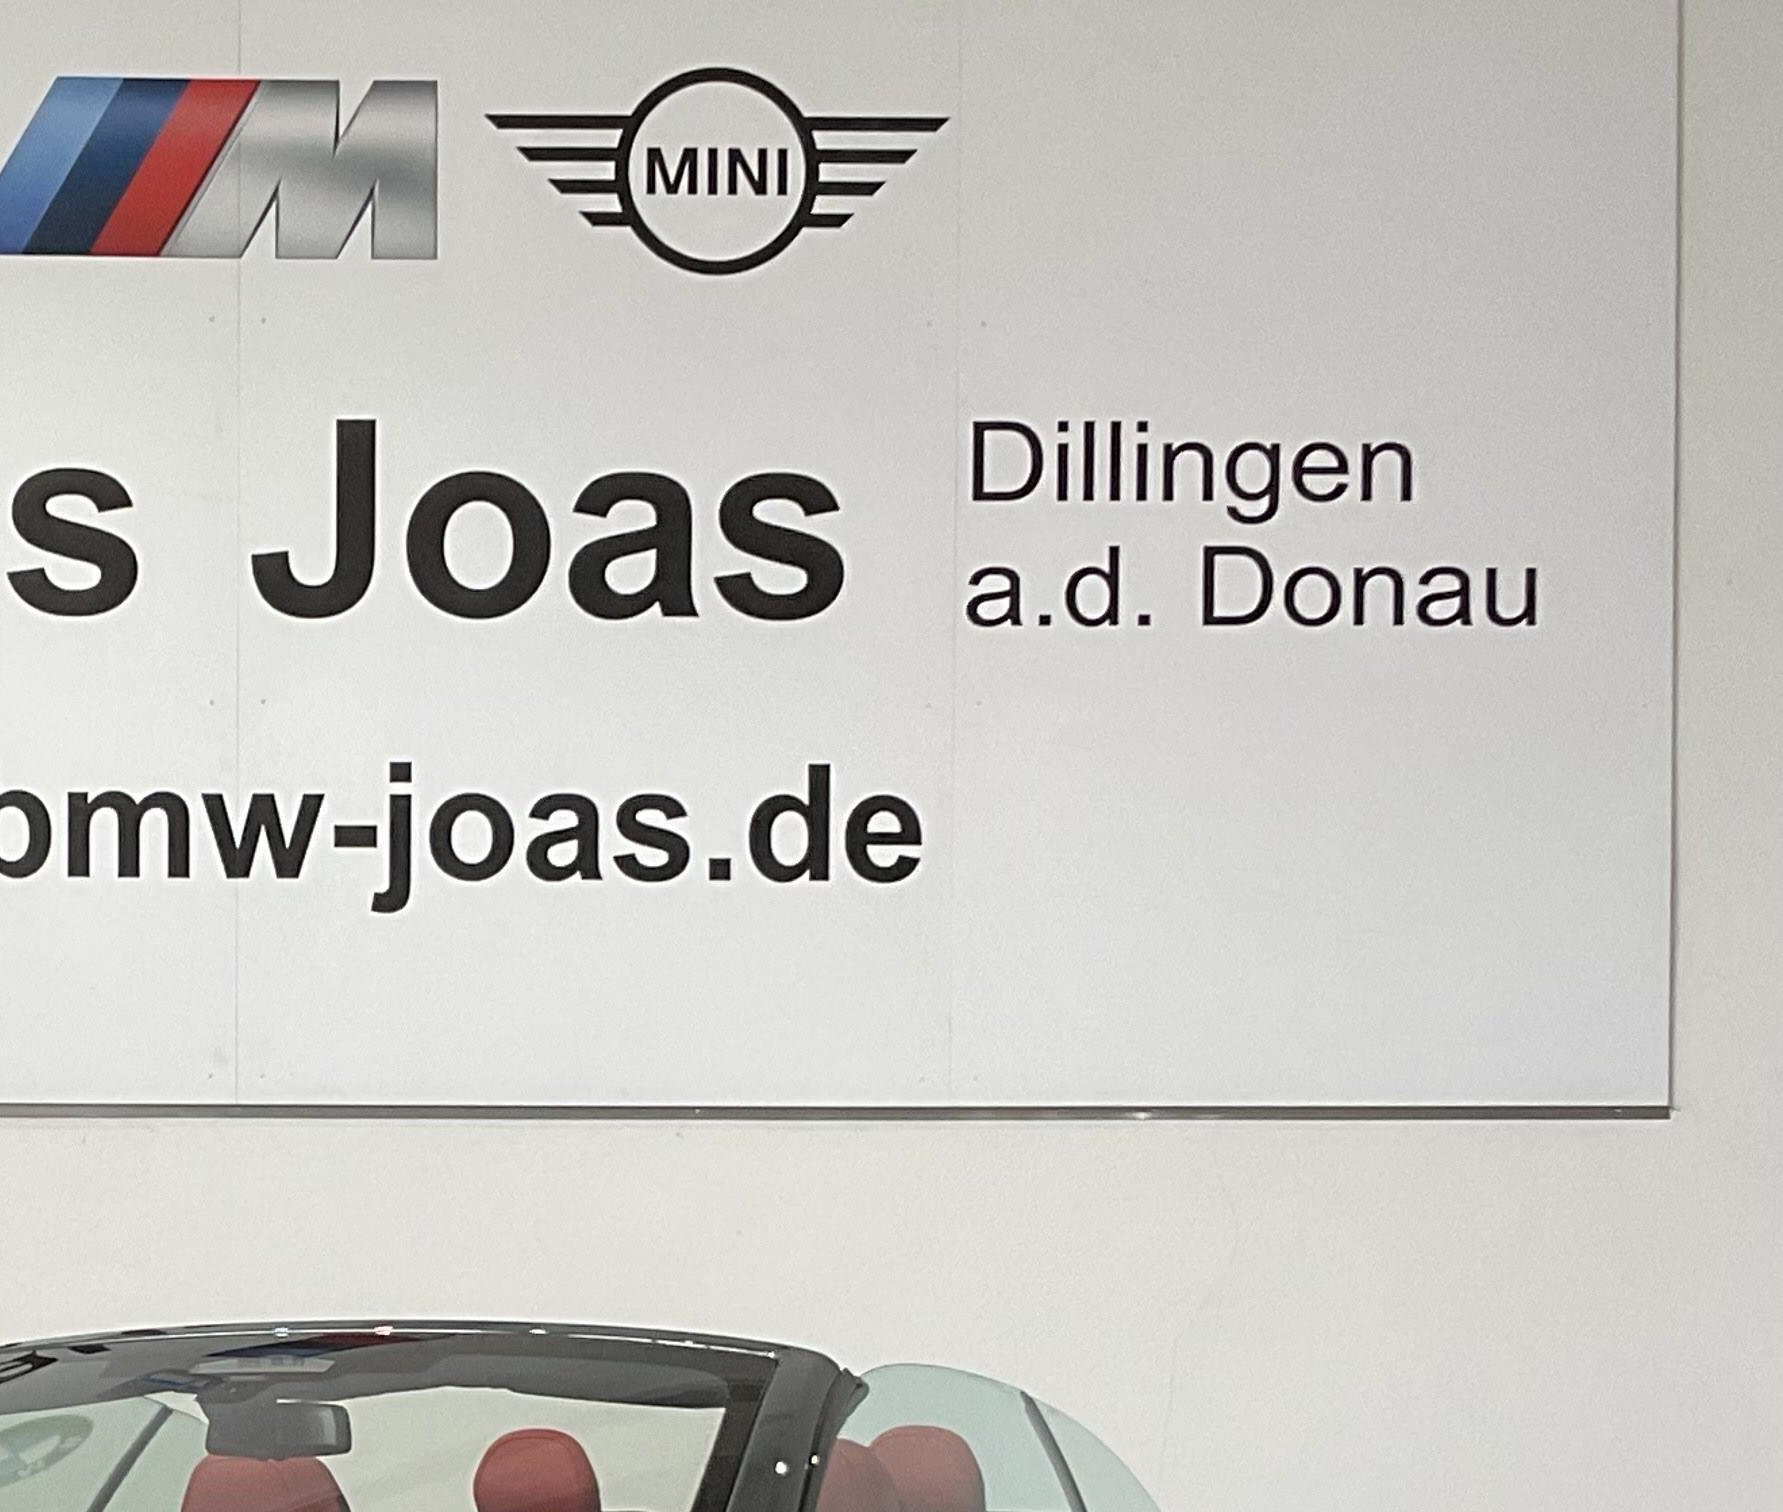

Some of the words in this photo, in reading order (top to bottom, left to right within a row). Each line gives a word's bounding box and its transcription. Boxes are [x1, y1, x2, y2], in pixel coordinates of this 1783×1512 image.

[647, 148, 788, 196] MINI
[973, 421, 1412, 525] Dillingen
[252, 420, 845, 621] Joas
[967, 546, 1151, 628] a.d.
[1203, 546, 1537, 627] Donau
